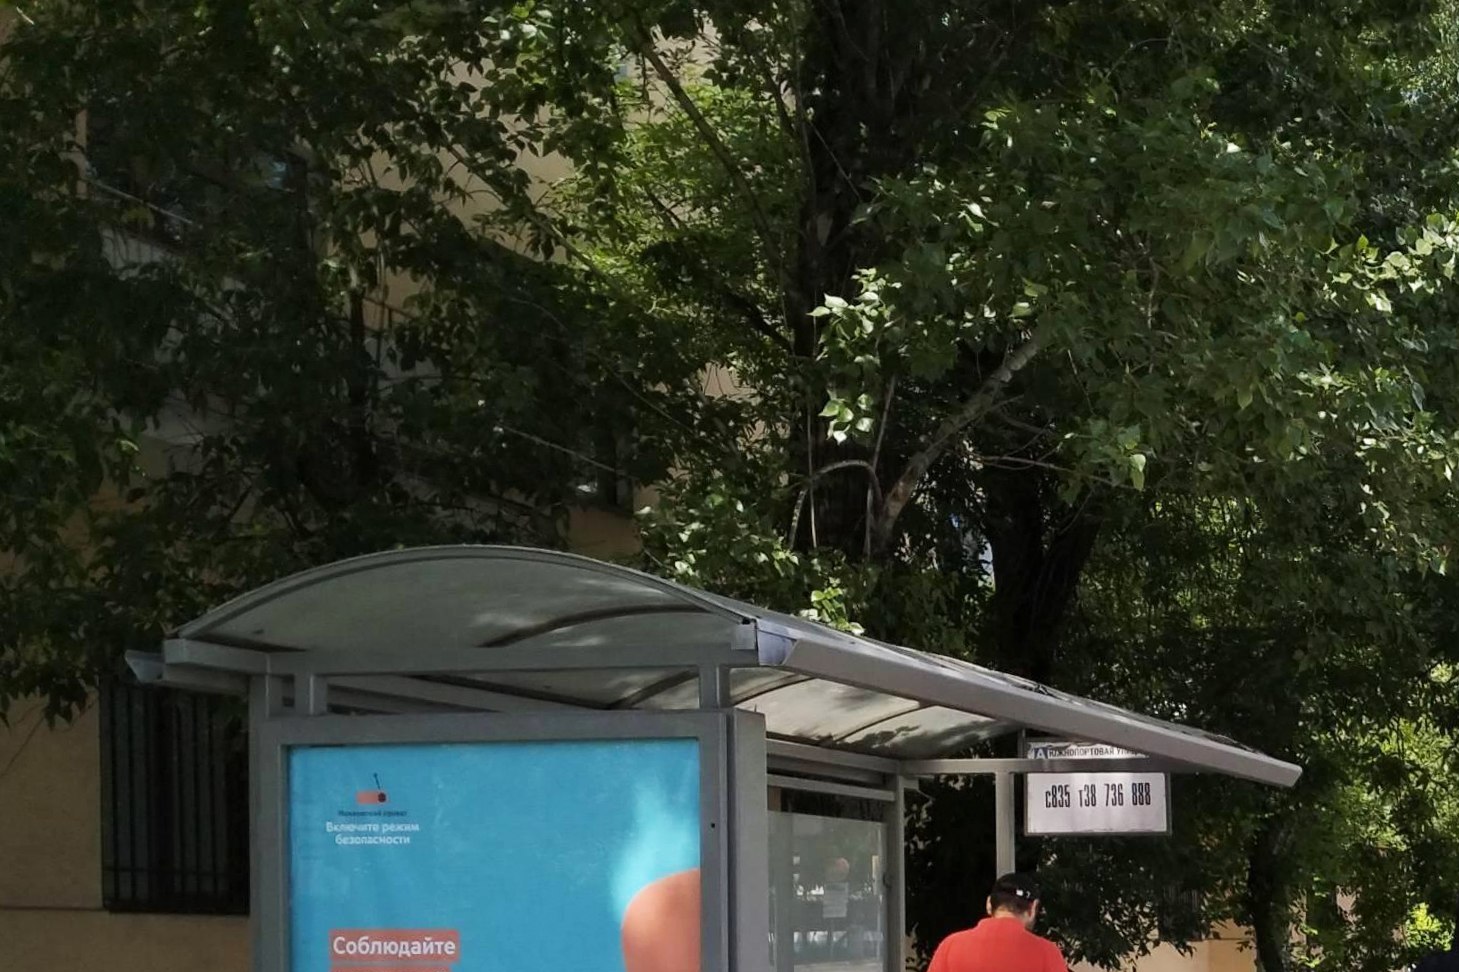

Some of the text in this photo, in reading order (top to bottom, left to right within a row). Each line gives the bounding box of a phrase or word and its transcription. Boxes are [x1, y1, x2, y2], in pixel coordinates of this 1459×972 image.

[1104, 783, 1124, 806] 736
[1131, 782, 1151, 805] 888
[382, 824, 420, 833] режим
[335, 834, 411, 844] безопасности
[333, 936, 456, 957] Соблюдайте
